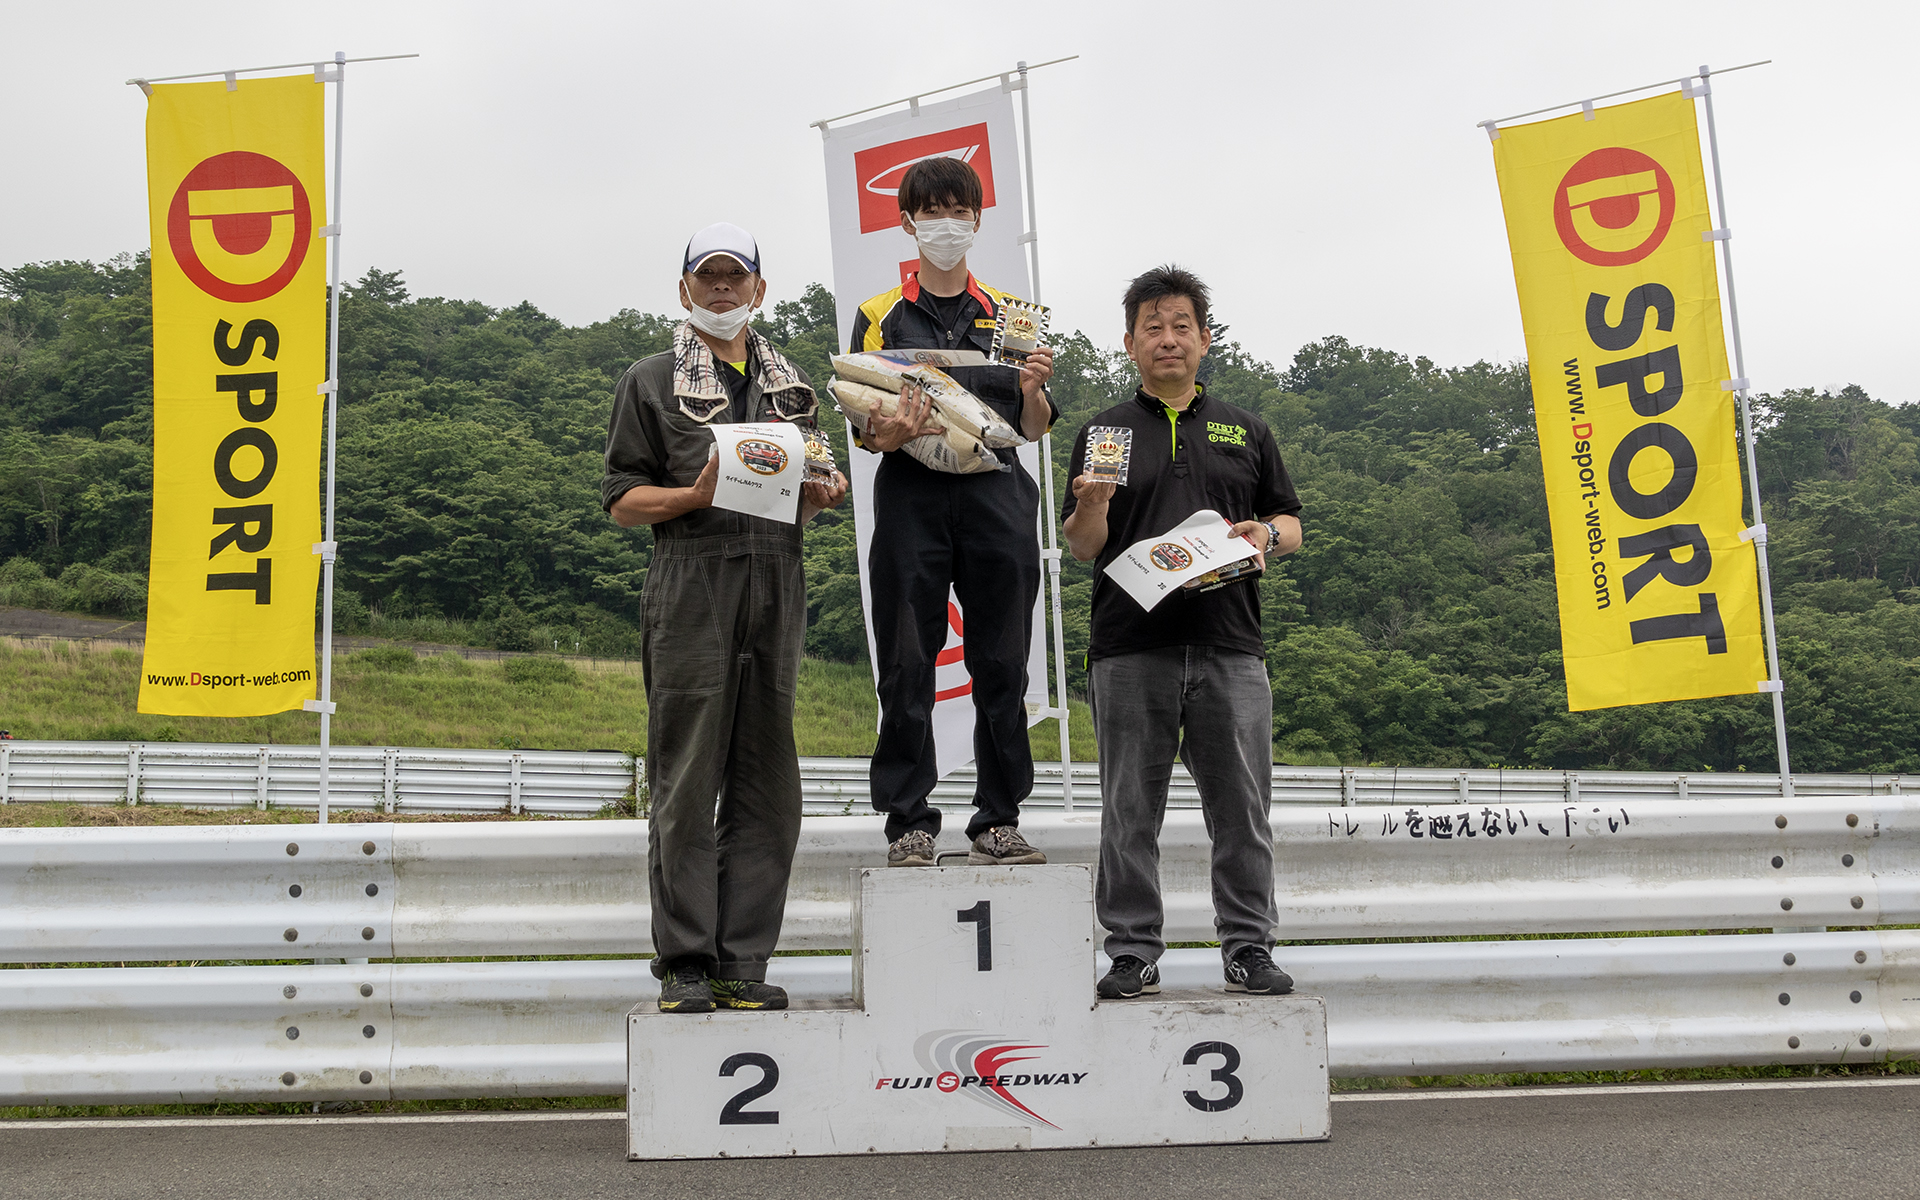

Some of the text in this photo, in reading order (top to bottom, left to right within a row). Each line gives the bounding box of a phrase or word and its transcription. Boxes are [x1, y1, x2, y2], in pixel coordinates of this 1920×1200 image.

[205, 318, 280, 605] SPORT
[1563, 357, 1611, 611] www.Dsport-web.com
[1584, 282, 1728, 655] SPORT
[147, 669, 311, 690] www.Dsport-web.com
[957, 900, 993, 972] 1
[718, 1052, 780, 1126] 2
[875, 1071, 1089, 1093] FUJI SPEEDWAY
[1182, 1040, 1244, 1113] 3
